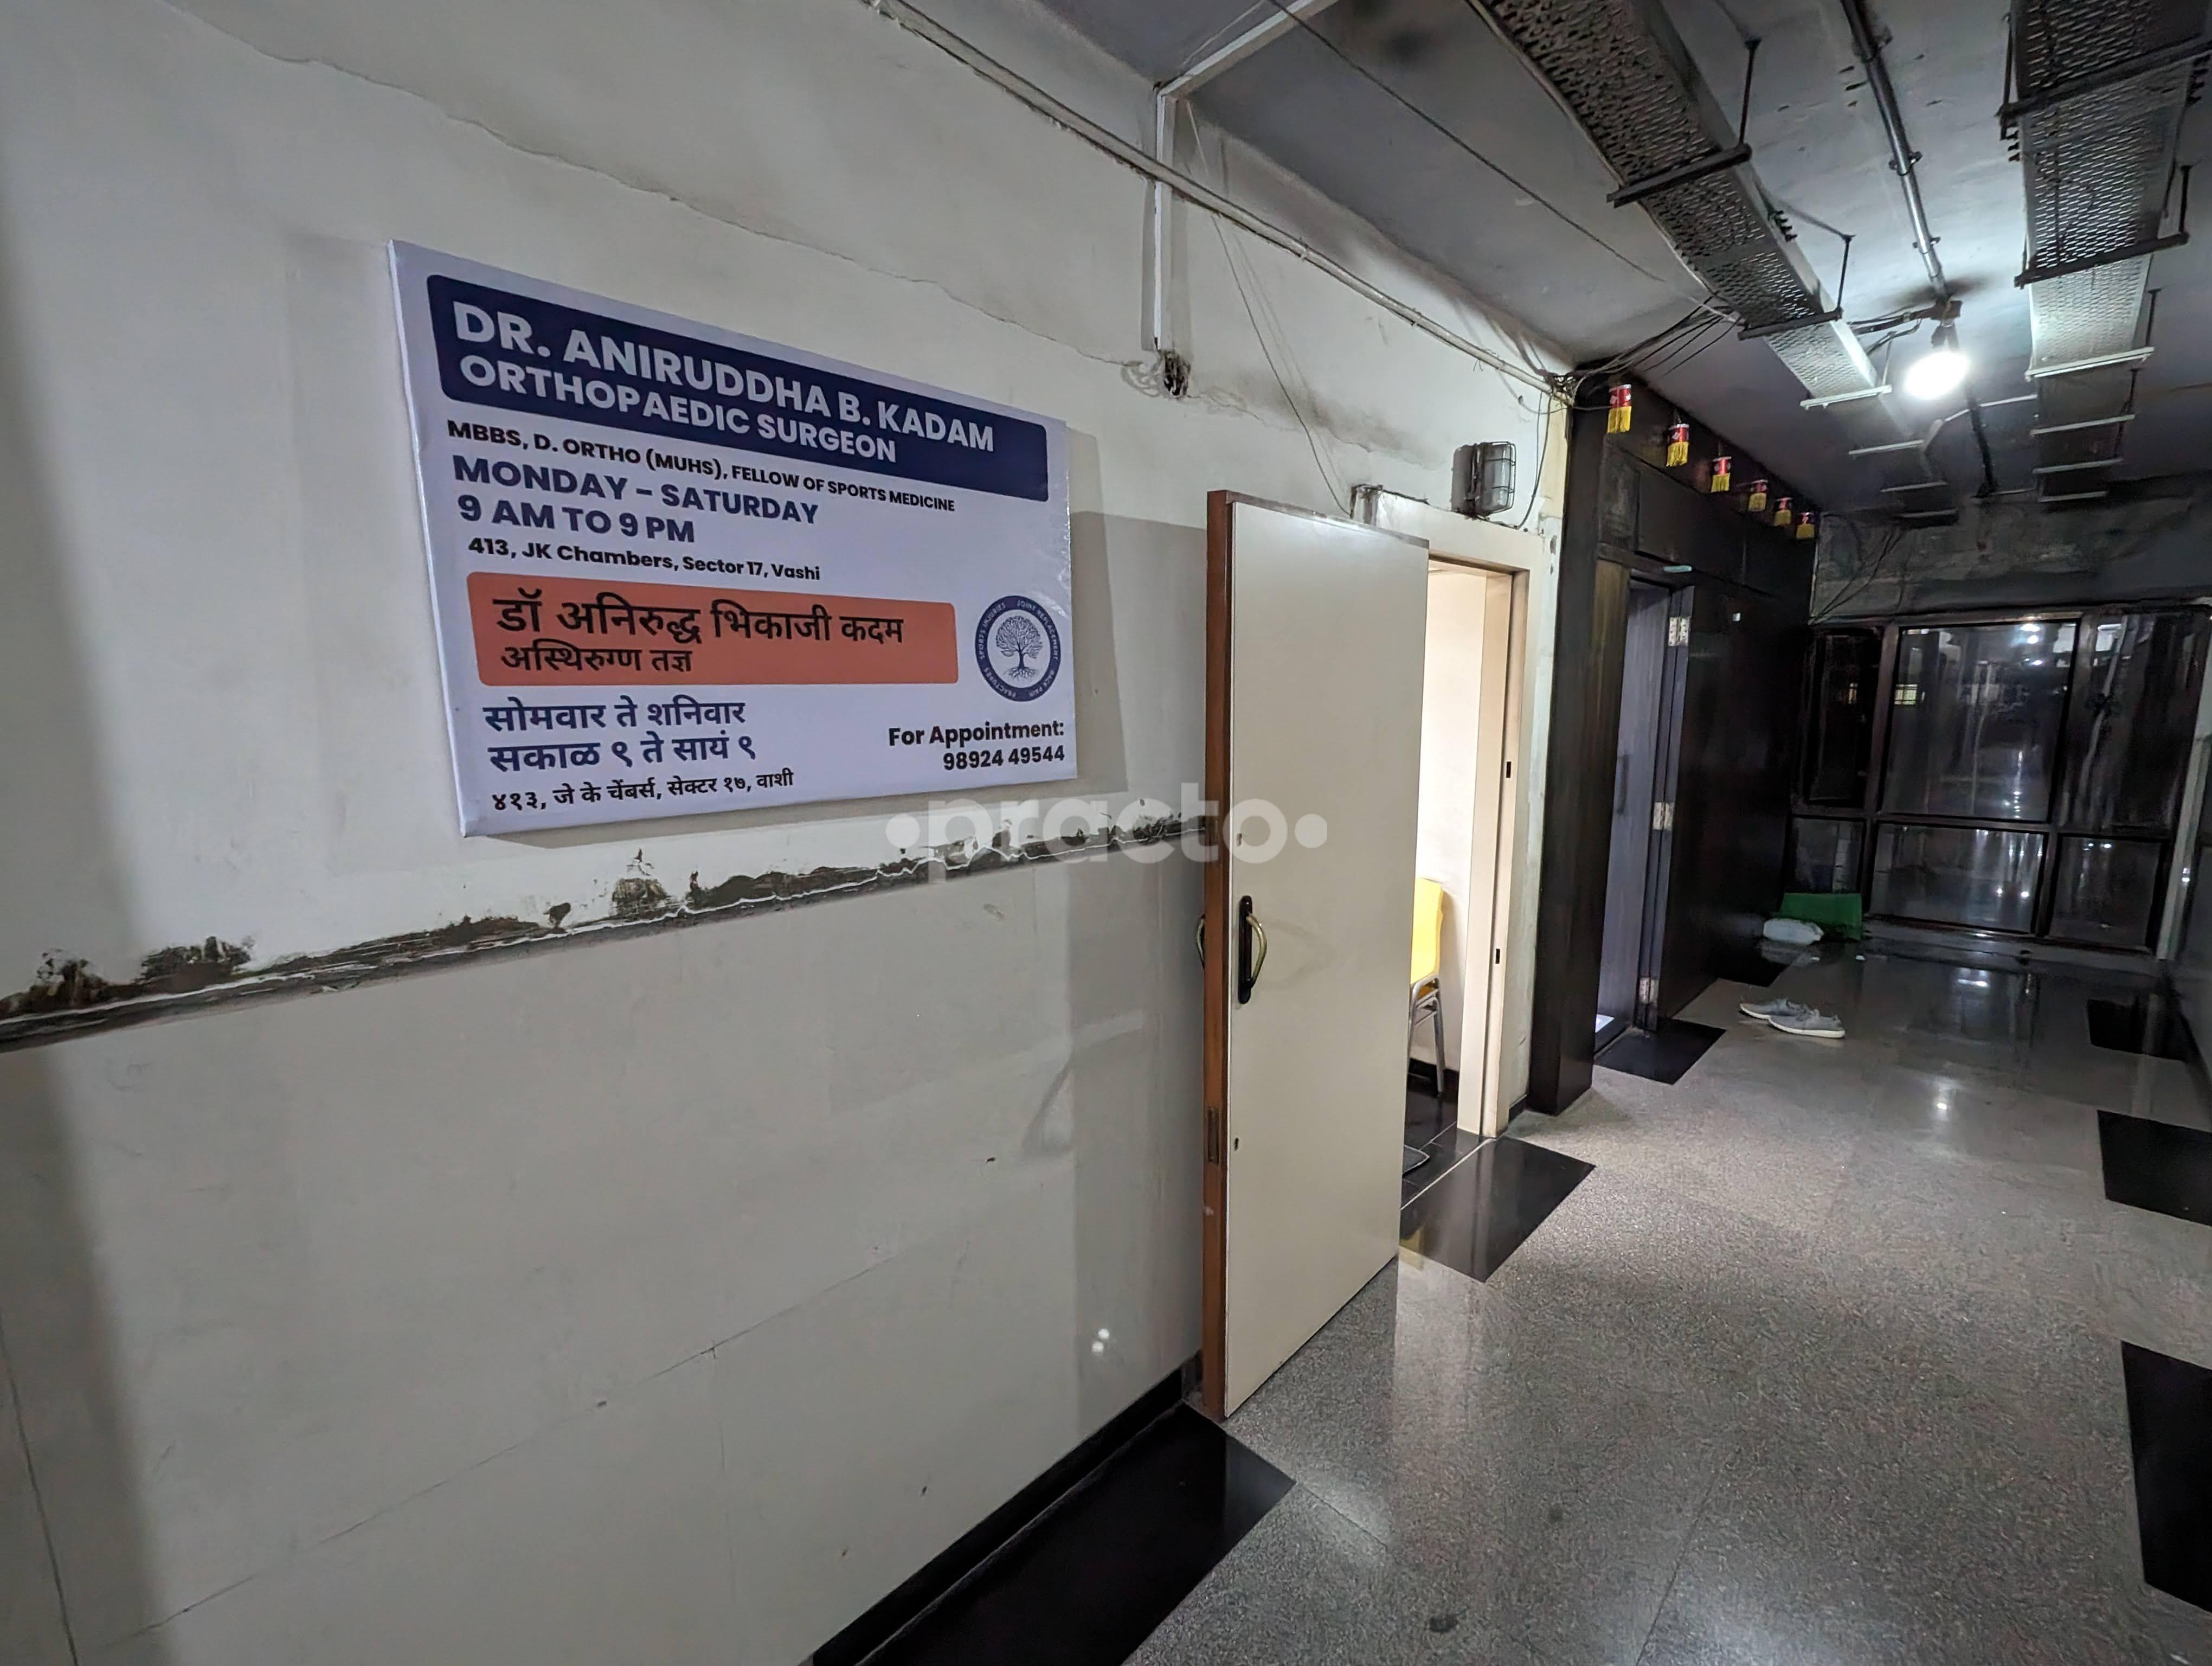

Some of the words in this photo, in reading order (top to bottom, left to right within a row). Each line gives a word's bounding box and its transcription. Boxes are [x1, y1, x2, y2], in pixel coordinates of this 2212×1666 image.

[452, 301, 551, 356] DR.
[563, 329, 831, 417] ANIRUDDHA
[839, 392, 870, 425] B.
[878, 401, 993, 452] KADAM
[460, 355, 750, 434] ORTHOPAEDIC
[757, 414, 896, 463] SURGEON
[447, 420, 528, 450] MBBS,
[534, 434, 558, 452] D.
[563, 439, 641, 464] ORTHO
[646, 448, 728, 480] (MUHS),
[732, 466, 800, 488] FELLOW
[803, 477, 825, 491] OF
[828, 480, 886, 502] SPORTS
[889, 491, 955, 511] MEDICINE
[452, 456, 627, 499] MONDAY
[661, 484, 818, 524] SATURDAY
[458, 495, 481, 521] 9
[492, 499, 555, 530] AM
[562, 507, 610, 535] TO
[620, 515, 638, 537] 9
[647, 519, 695, 542] PM
[468, 537, 516, 558] 413,
[522, 543, 552, 559] JK
[557, 545, 678, 571] Chambers,
[683, 556, 744, 575] Sector
[748, 561, 768, 578] 17,
[771, 563, 820, 580] Vashi
[493, 587, 542, 632] डॉ
[556, 592, 702, 644] अनिरुद्ध
[710, 598, 831, 640] भिकाजी
[839, 616, 903, 644] कदम
[501, 639, 642, 671] अस्थिरुग्ण
[650, 650, 692, 672] तज्ञ
[483, 696, 606, 732] सोमवार
[615, 695, 637, 727] ते
[647, 694, 745, 726] शनिवार
[889, 726, 924, 746] For
[929, 720, 1064, 748] Appointment:
[488, 742, 600, 772] सकाळ
[611, 741, 633, 767] ९
[640, 731, 663, 762] ते
[672, 731, 729, 760] सायं
[738, 736, 756, 760] ९
[944, 750, 1003, 771] 98924
[1008, 746, 1064, 765] 49544
[492, 792, 546, 810] ४१३,
[554, 783, 574, 805] जे
[581, 781, 601, 802] के
[607, 778, 661, 800] चेंबर्स,
[667, 775, 717, 796] सेक्टर
[724, 776, 750, 792] १७,
[756, 768, 794, 787] वाशी
